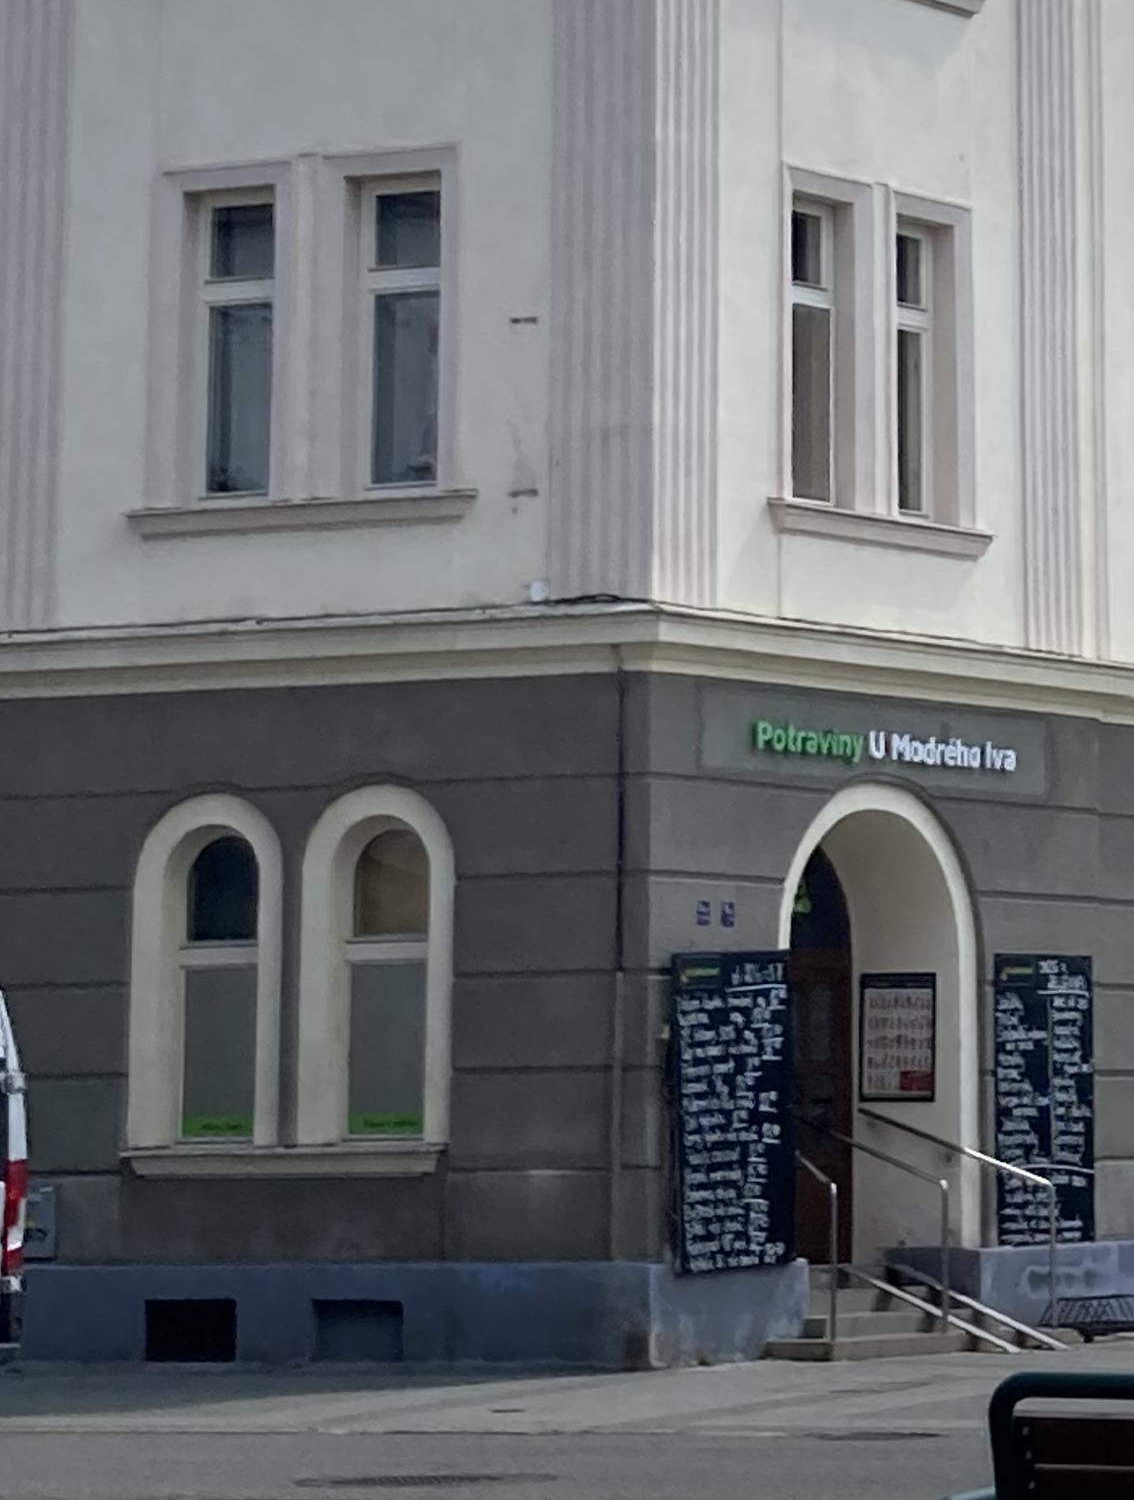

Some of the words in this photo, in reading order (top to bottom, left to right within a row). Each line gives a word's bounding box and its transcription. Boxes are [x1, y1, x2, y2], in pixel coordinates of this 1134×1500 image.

[754, 720, 864, 763] Potraviny
[868, 730, 887, 760] U
[890, 732, 982, 769] Modrého
